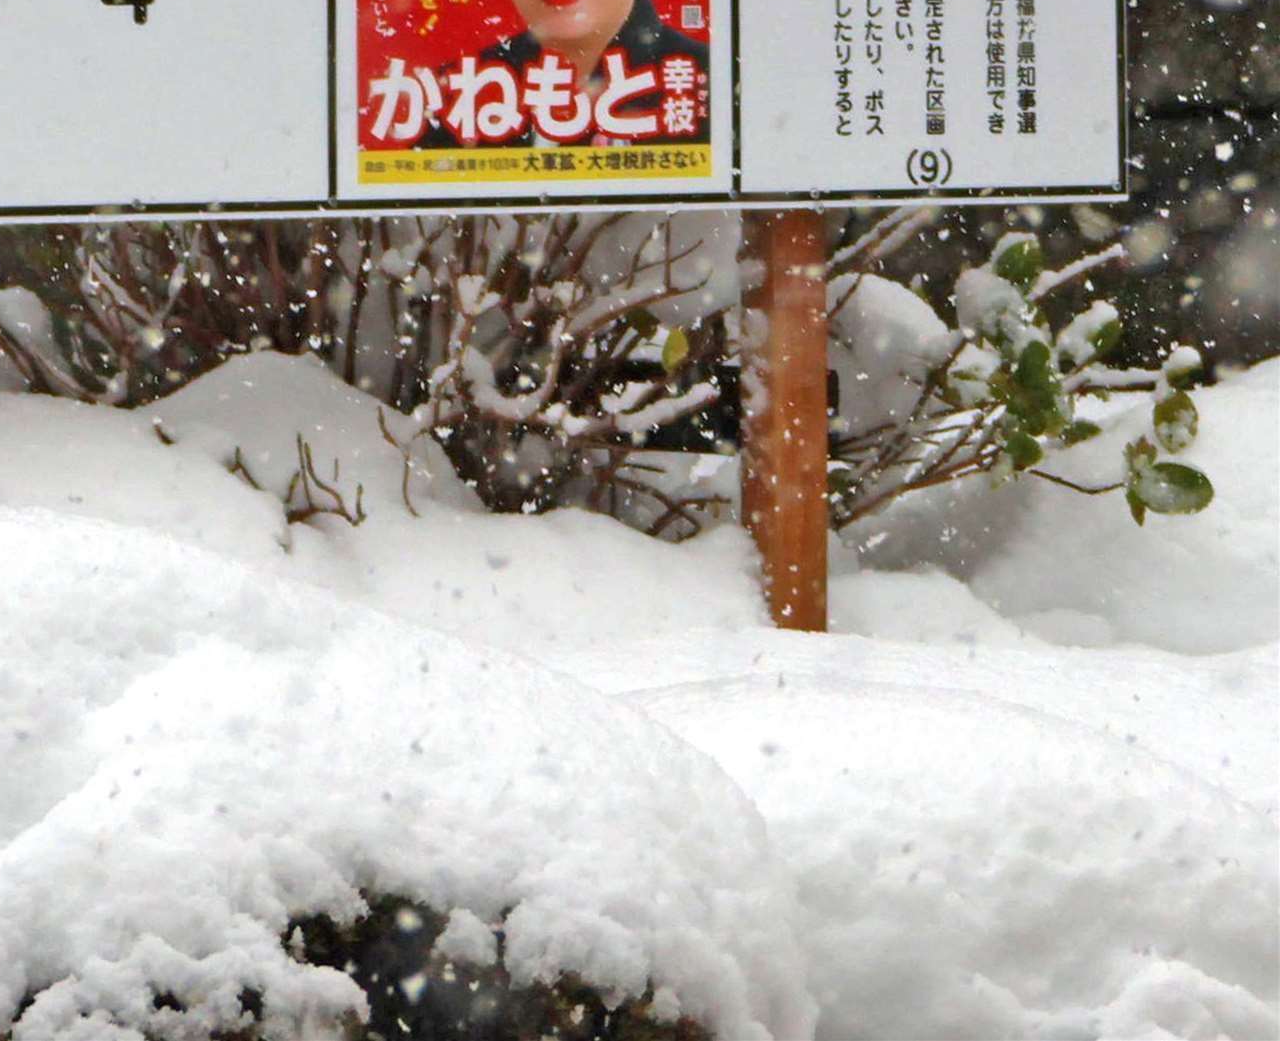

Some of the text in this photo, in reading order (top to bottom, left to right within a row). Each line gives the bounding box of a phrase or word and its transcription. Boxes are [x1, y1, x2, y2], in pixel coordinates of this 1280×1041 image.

[369, 54, 658, 140] かねもと
[662, 58, 696, 134] 幸枝
[907, 148, 953, 186] (9)
